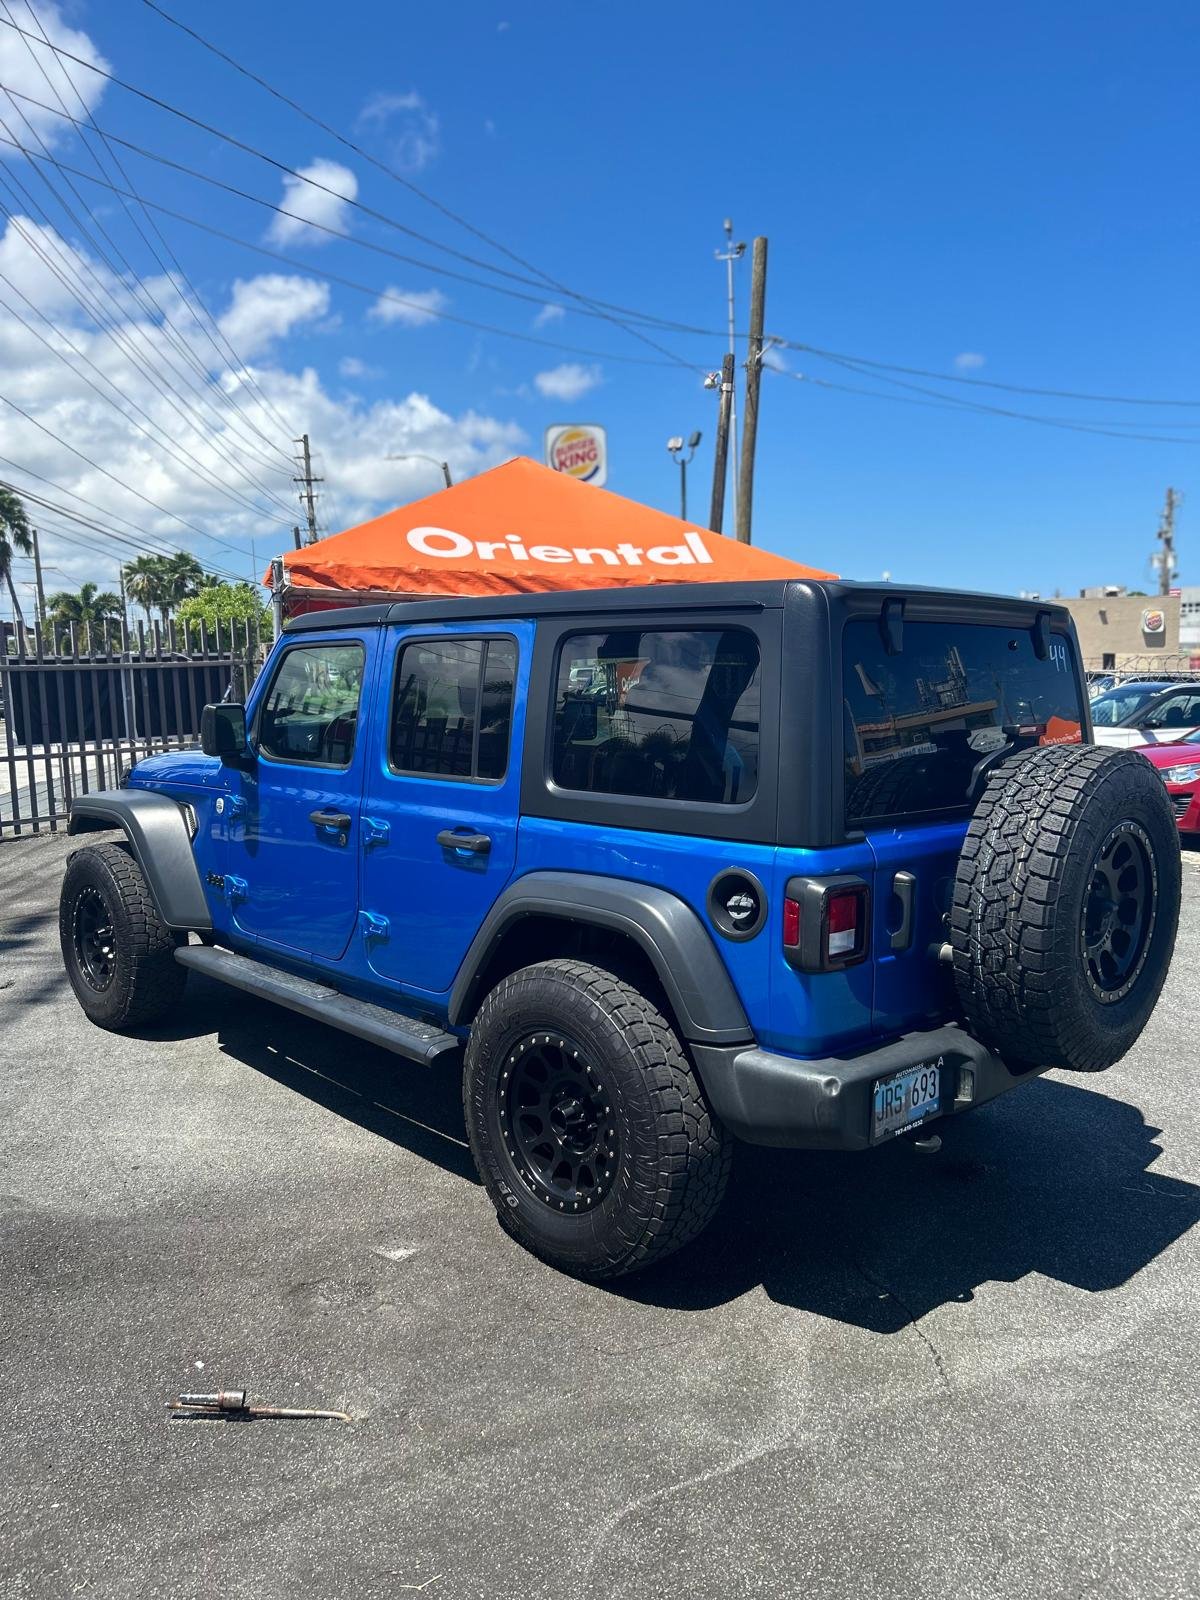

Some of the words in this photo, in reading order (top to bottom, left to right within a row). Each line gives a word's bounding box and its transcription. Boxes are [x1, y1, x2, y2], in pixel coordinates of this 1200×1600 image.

[556, 438, 596, 458] BURGER
[558, 447, 598, 472] KING
[406, 526, 714, 567] Oriental
[876, 1083, 903, 1122] JRS
[911, 1069, 937, 1107] 693
